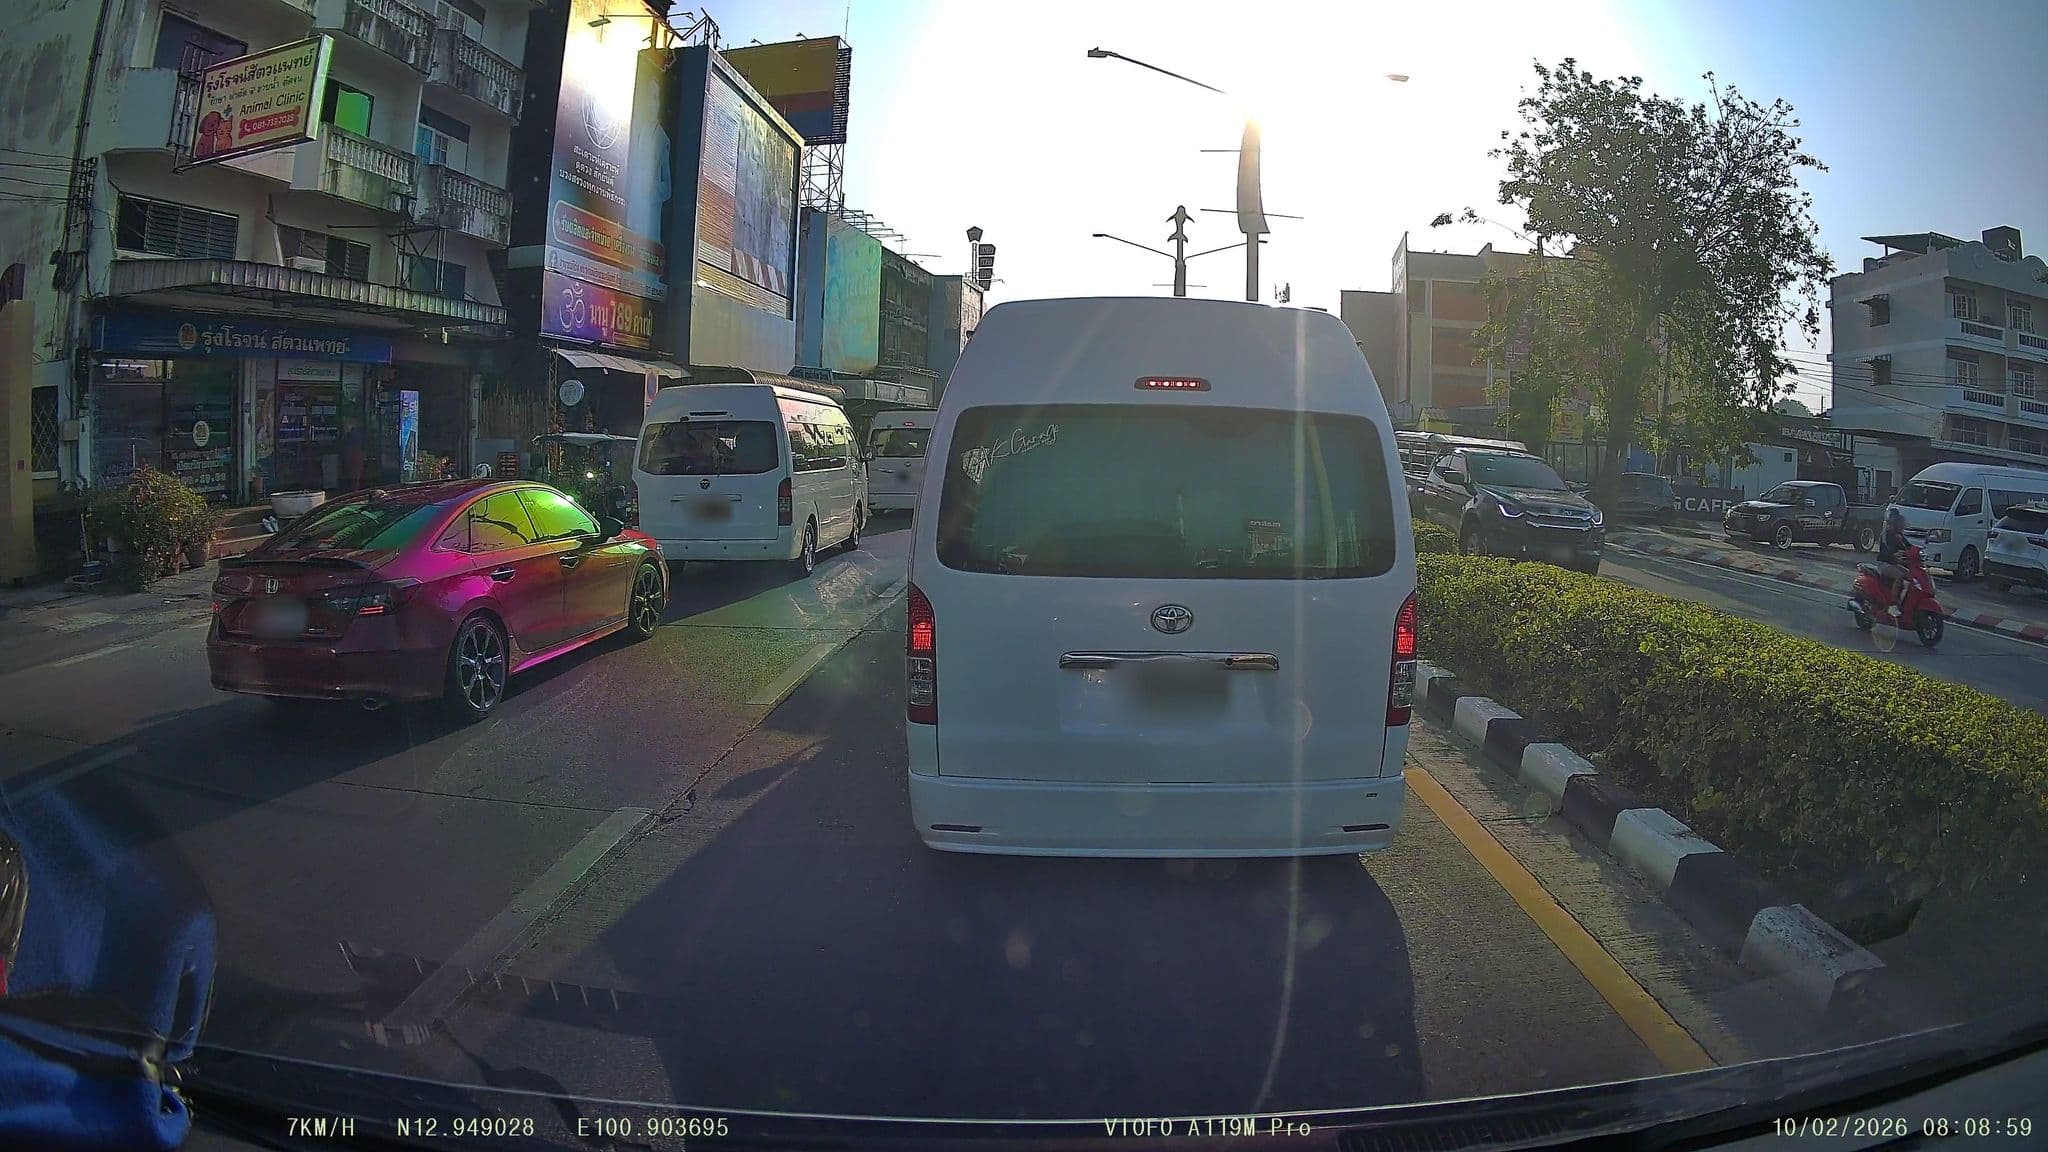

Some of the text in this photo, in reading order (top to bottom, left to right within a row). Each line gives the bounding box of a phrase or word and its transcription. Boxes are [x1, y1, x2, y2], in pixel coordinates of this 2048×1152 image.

[206, 48, 315, 98] รุ่งโรจน์สัตวแพทย์
[240, 91, 305, 116] Animal Clinic
[610, 300, 633, 332] 789
[201, 325, 347, 354] รุ่งโรจน์ สัตวแพทย์
[1010, 423, 1060, 455] Garage
